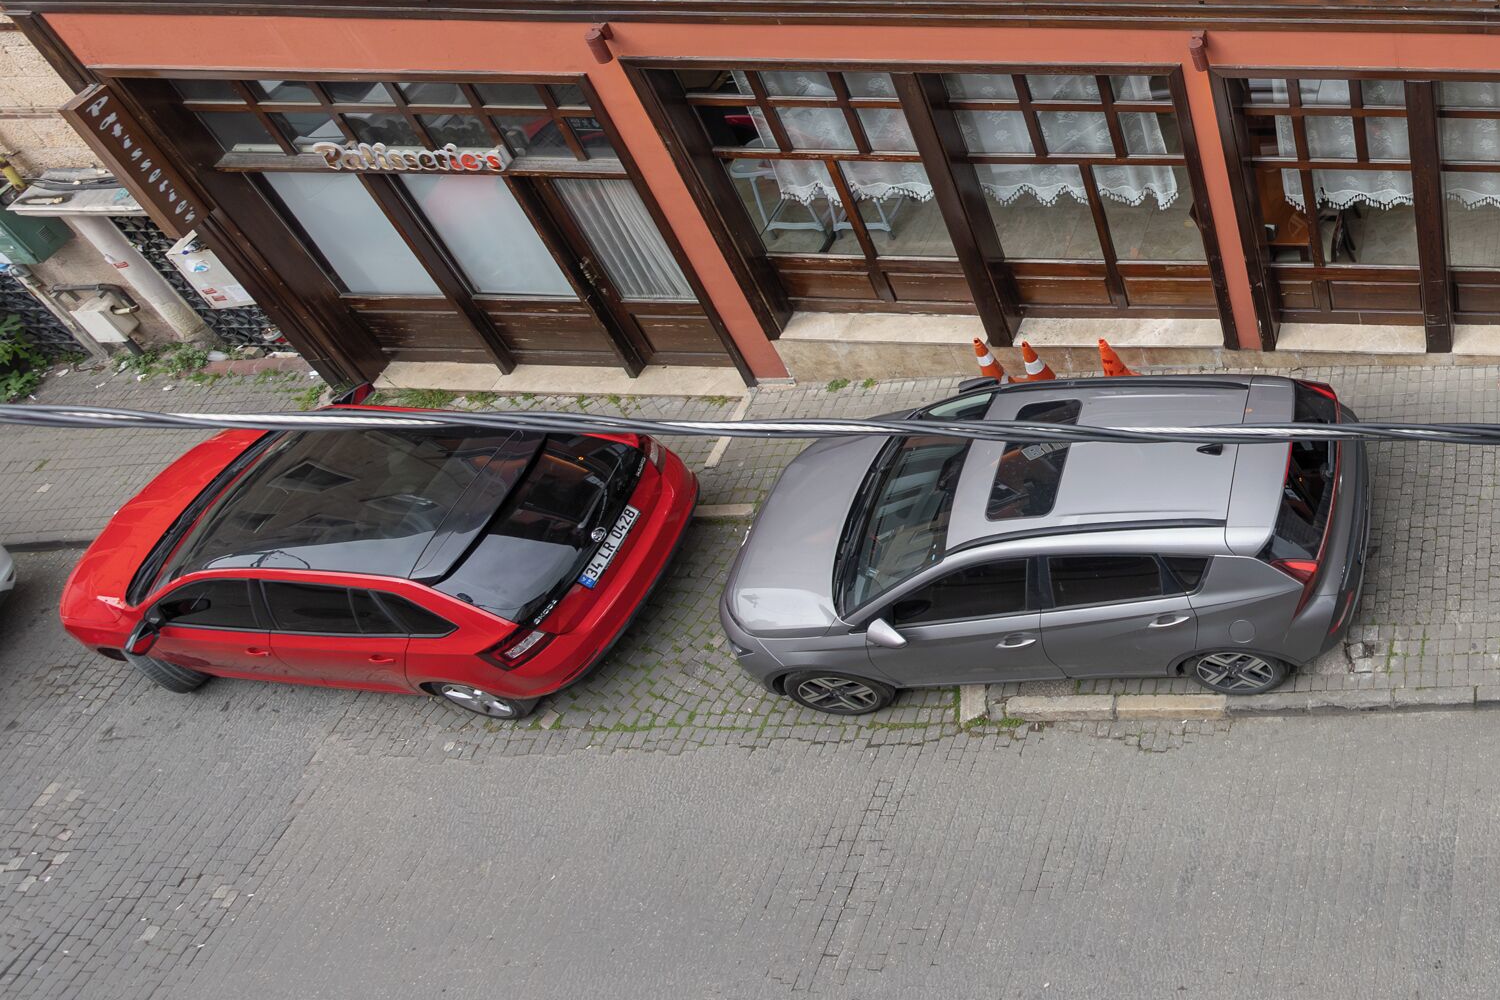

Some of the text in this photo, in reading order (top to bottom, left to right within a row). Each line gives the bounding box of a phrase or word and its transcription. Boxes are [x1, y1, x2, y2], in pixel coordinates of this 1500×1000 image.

[312, 141, 510, 172] Patisserie's
[585, 508, 636, 578] 34 LR 0428
